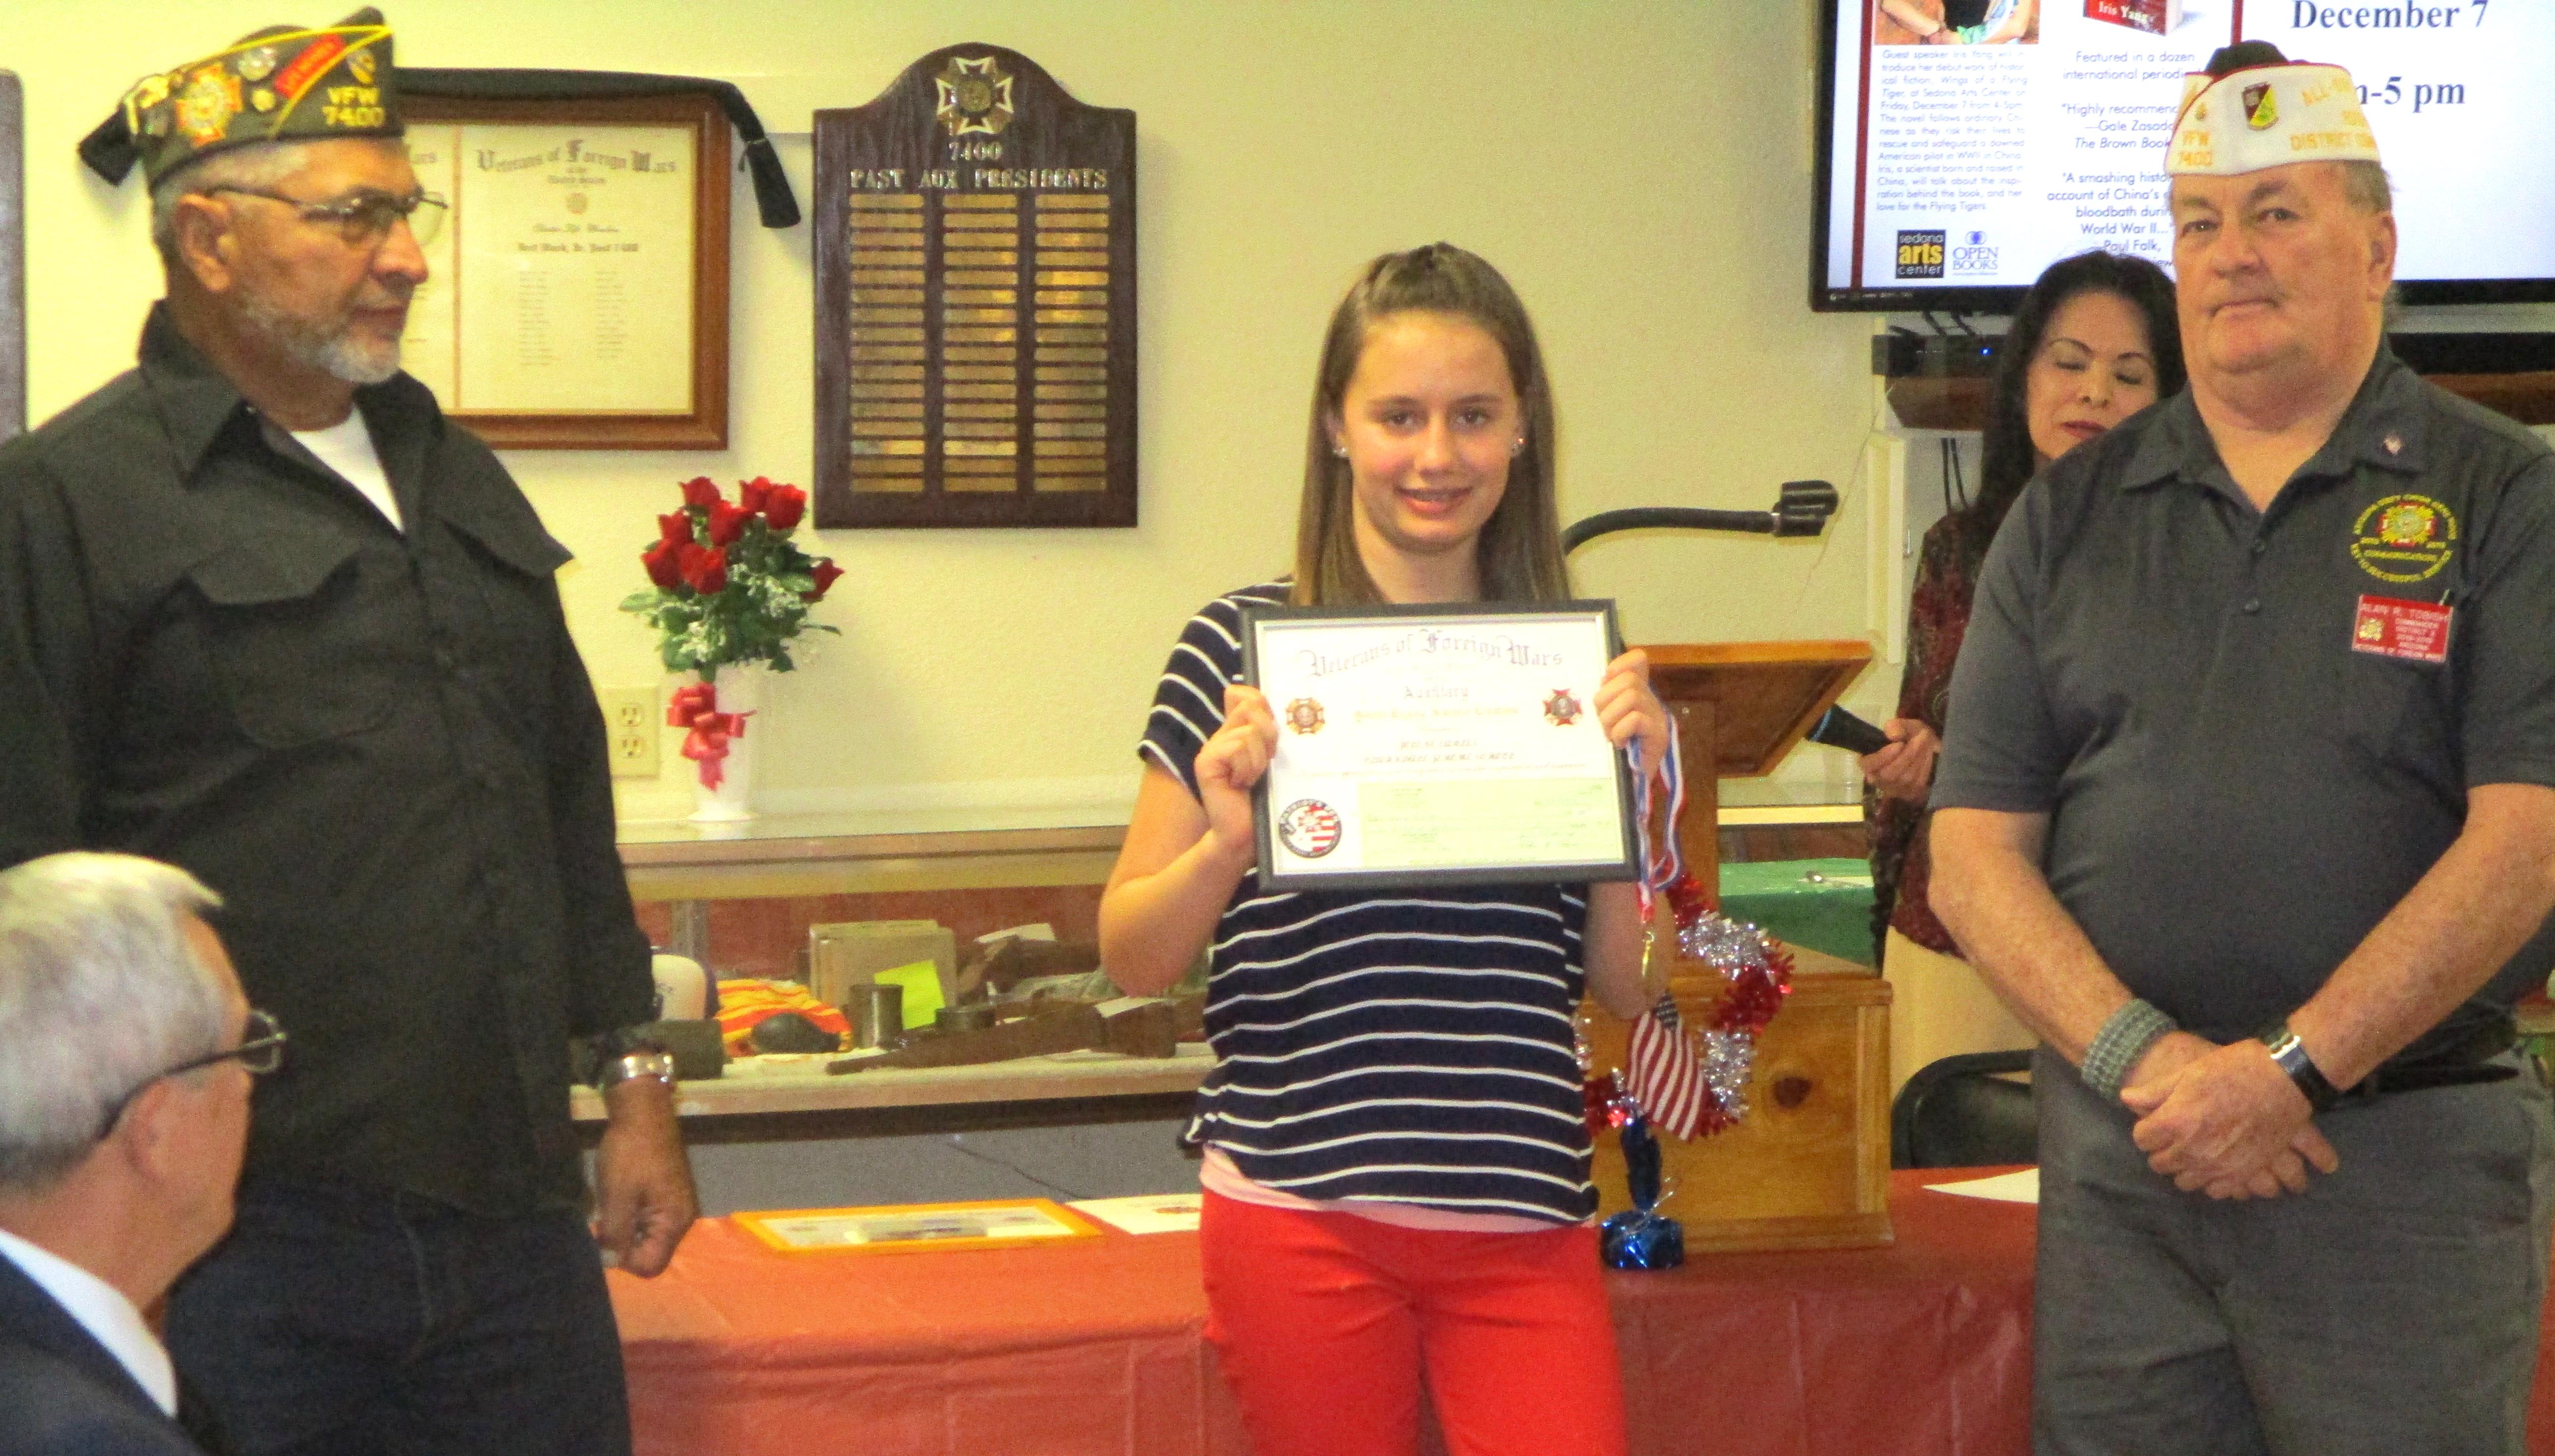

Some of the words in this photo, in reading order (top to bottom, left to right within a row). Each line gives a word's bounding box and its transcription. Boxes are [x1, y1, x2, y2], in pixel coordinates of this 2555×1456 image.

[2290, 0, 2460, 28] December
[2471, 0, 2488, 27] 7
[1882, 50, 1909, 59] Guest
[1913, 51, 1948, 61] speaker
[1972, 50, 1993, 60] Yang
[2076, 51, 2128, 62] Featured
[2133, 52, 2142, 61] in
[2148, 53, 2155, 61] a
[2159, 51, 2195, 62] dozen
[1882, 63, 1916, 71] troduce
[2063, 68, 2137, 79] international
[2142, 68, 2184, 81] periodi
[1941, 76, 1968, 86] Wings
[1975, 76, 1984, 84] of
[327, 86, 380, 107] VFW
[1923, 88, 1956, 97] Sedona
[1982, 88, 2011, 97] Center
[2413, 83, 2465, 113] pm
[1913, 101, 1958, 110] December
[322, 106, 386, 127] 7400
[1881, 114, 1896, 122] The
[1900, 114, 1925, 122] novel
[1930, 114, 1961, 122] follows
[1932, 139, 1977, 149] safeguard
[2075, 137, 2095, 148] The
[2100, 137, 2137, 148] Brown
[949, 141, 1003, 161] 7400
[1878, 152, 1921, 160] American
[1966, 164, 1983, 172] and
[851, 169, 905, 189] PAST
[919, 169, 959, 188] AUX
[975, 168, 1107, 189] PRESIDENTS
[2078, 172, 2135, 185] smashing
[1907, 189, 1938, 198] behind
[1987, 189, 2004, 197] and
[2047, 189, 2094, 200] account
[2097, 188, 2110, 200] of
[2114, 188, 2159, 200] China's
[1930, 201, 1957, 212] Flying
[2075, 206, 2136, 217] bloodbath
[2080, 223, 2117, 234] World
[2120, 223, 2146, 234] War
[1898, 234, 1944, 243] sedona
[1898, 243, 1943, 265] arts
[1952, 247, 1999, 260] OPEN
[1896, 265, 1941, 275] center
[1952, 259, 1998, 270] BOOKS
